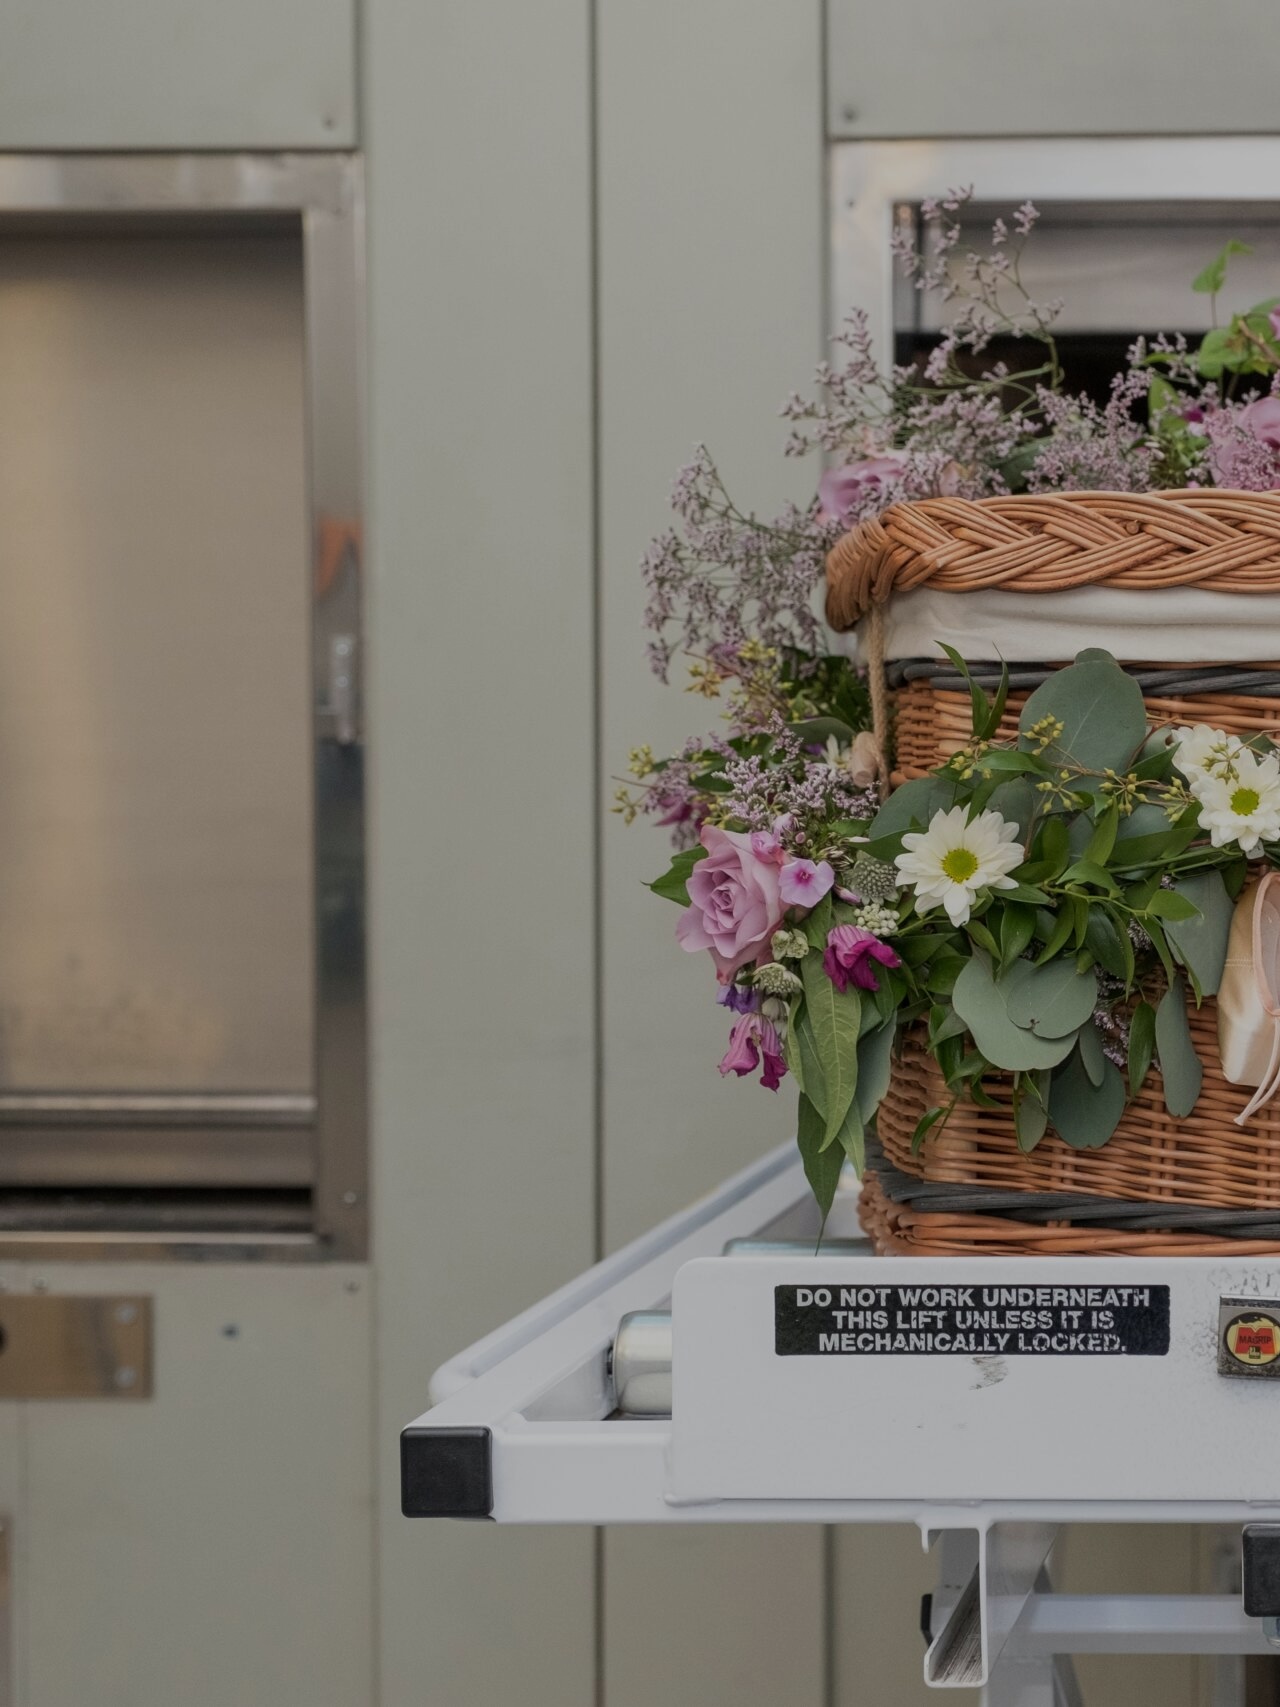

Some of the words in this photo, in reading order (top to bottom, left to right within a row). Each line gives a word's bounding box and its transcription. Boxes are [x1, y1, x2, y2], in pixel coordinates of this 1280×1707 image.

[796, 1289, 831, 1307] DO
[840, 1289, 890, 1307] NOT
[899, 1289, 974, 1308] WORK
[983, 1288, 1150, 1308] UNDERNEATH
[832, 1311, 888, 1329] THIS
[896, 1311, 947, 1329] LIFT
[956, 1311, 1052, 1329] UNLESS
[1061, 1311, 1083, 1329] IT
[1092, 1311, 1114, 1329] IS
[819, 1333, 1008, 1352] MECHANICALLY
[1018, 1334, 1126, 1352] LOCKED.
